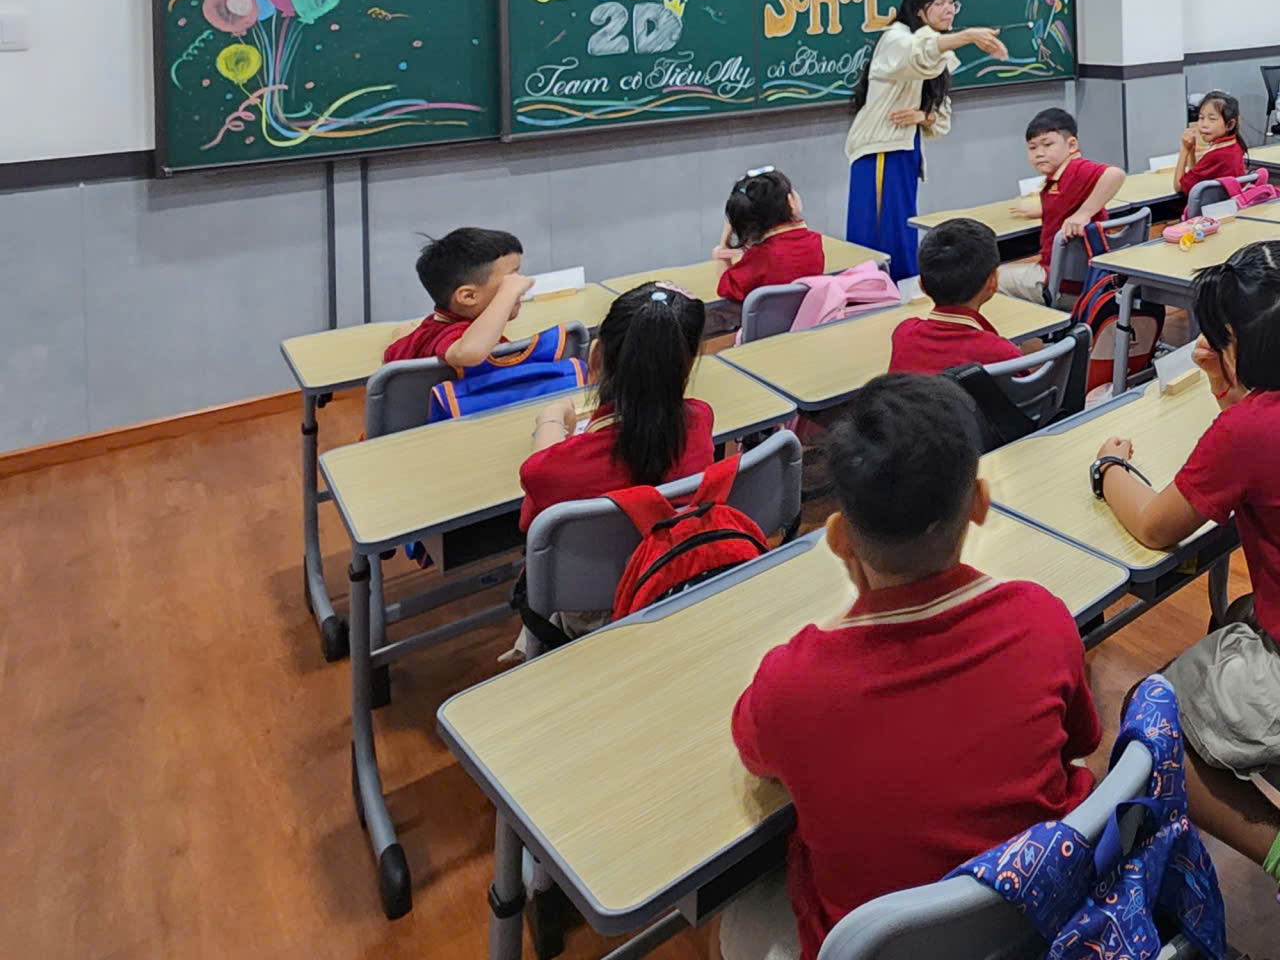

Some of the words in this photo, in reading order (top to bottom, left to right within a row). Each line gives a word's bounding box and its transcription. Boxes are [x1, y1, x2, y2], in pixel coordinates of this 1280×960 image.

[587, 2, 684, 56] 2D
[524, 56, 609, 96] Team
[619, 71, 642, 90] cô
[645, 50, 704, 89] Tiểu
[767, 60, 786, 78] cô
[789, 46, 836, 77] Bảo
